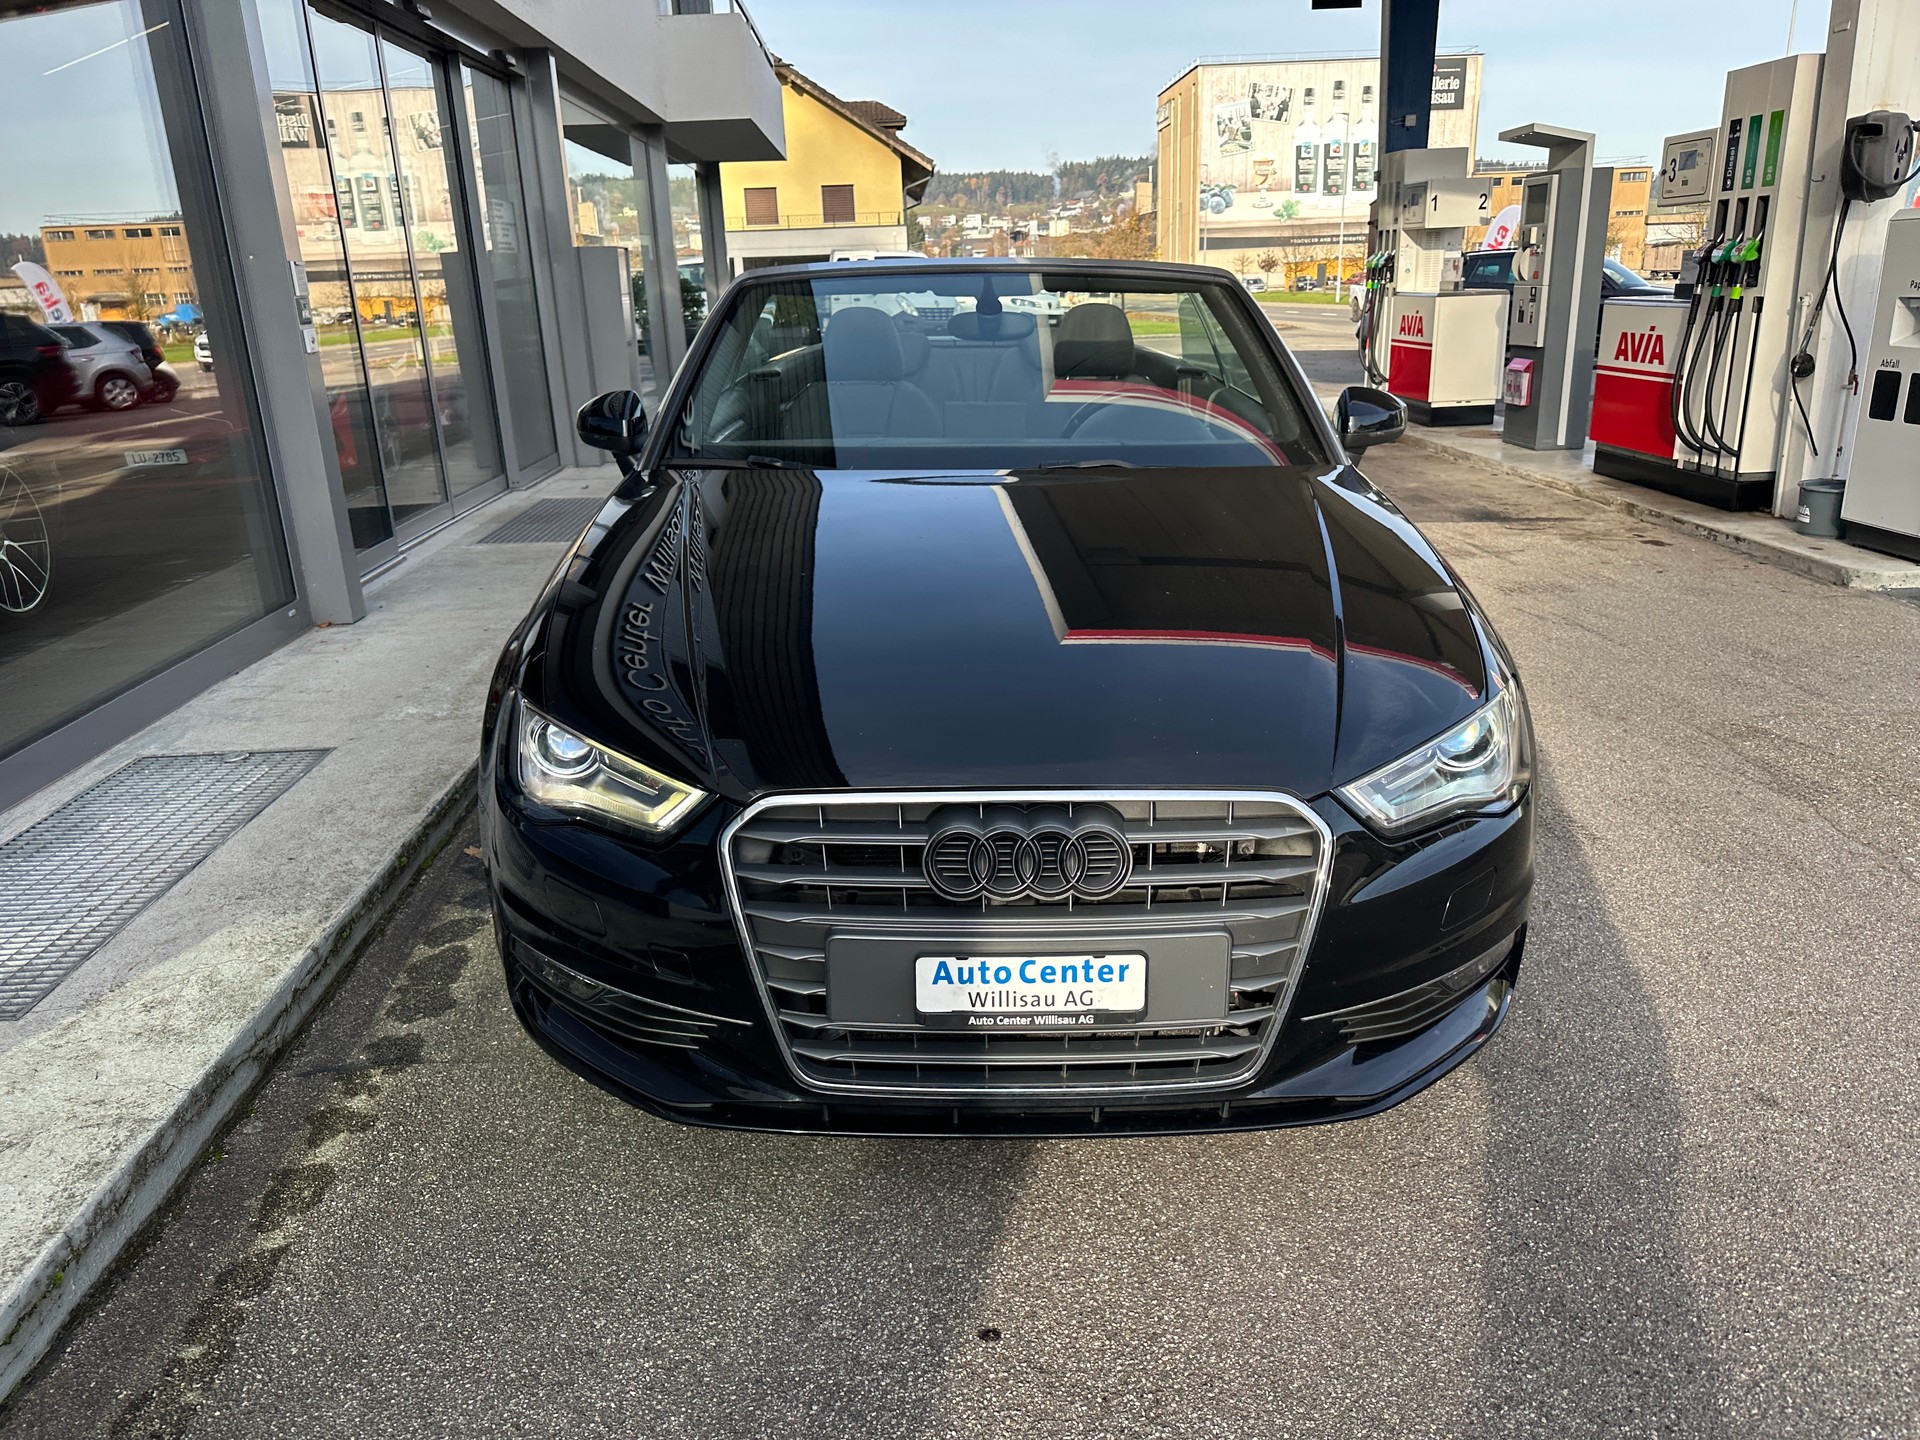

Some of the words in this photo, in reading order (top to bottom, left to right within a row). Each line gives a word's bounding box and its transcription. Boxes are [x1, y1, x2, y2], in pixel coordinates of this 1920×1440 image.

[1668, 158, 1677, 182] 3
[1726, 146, 1736, 177] Diesel
[1431, 194, 1439, 212] 1
[1478, 193, 1488, 210] 2
[1399, 310, 1424, 337] AVIA
[1614, 325, 1665, 365] AVIA
[1880, 359, 1900, 369] Abfall
[932, 960, 1013, 986] Auto
[1019, 959, 1130, 984] Center
[967, 991, 1056, 1008] Willisau
[1063, 990, 1094, 1007] AG
[968, 1015, 995, 1025] Auto
[996, 1015, 1032, 1025] Center
[1033, 1014, 1077, 1025] Willisau
[1078, 1014, 1095, 1025] AG
